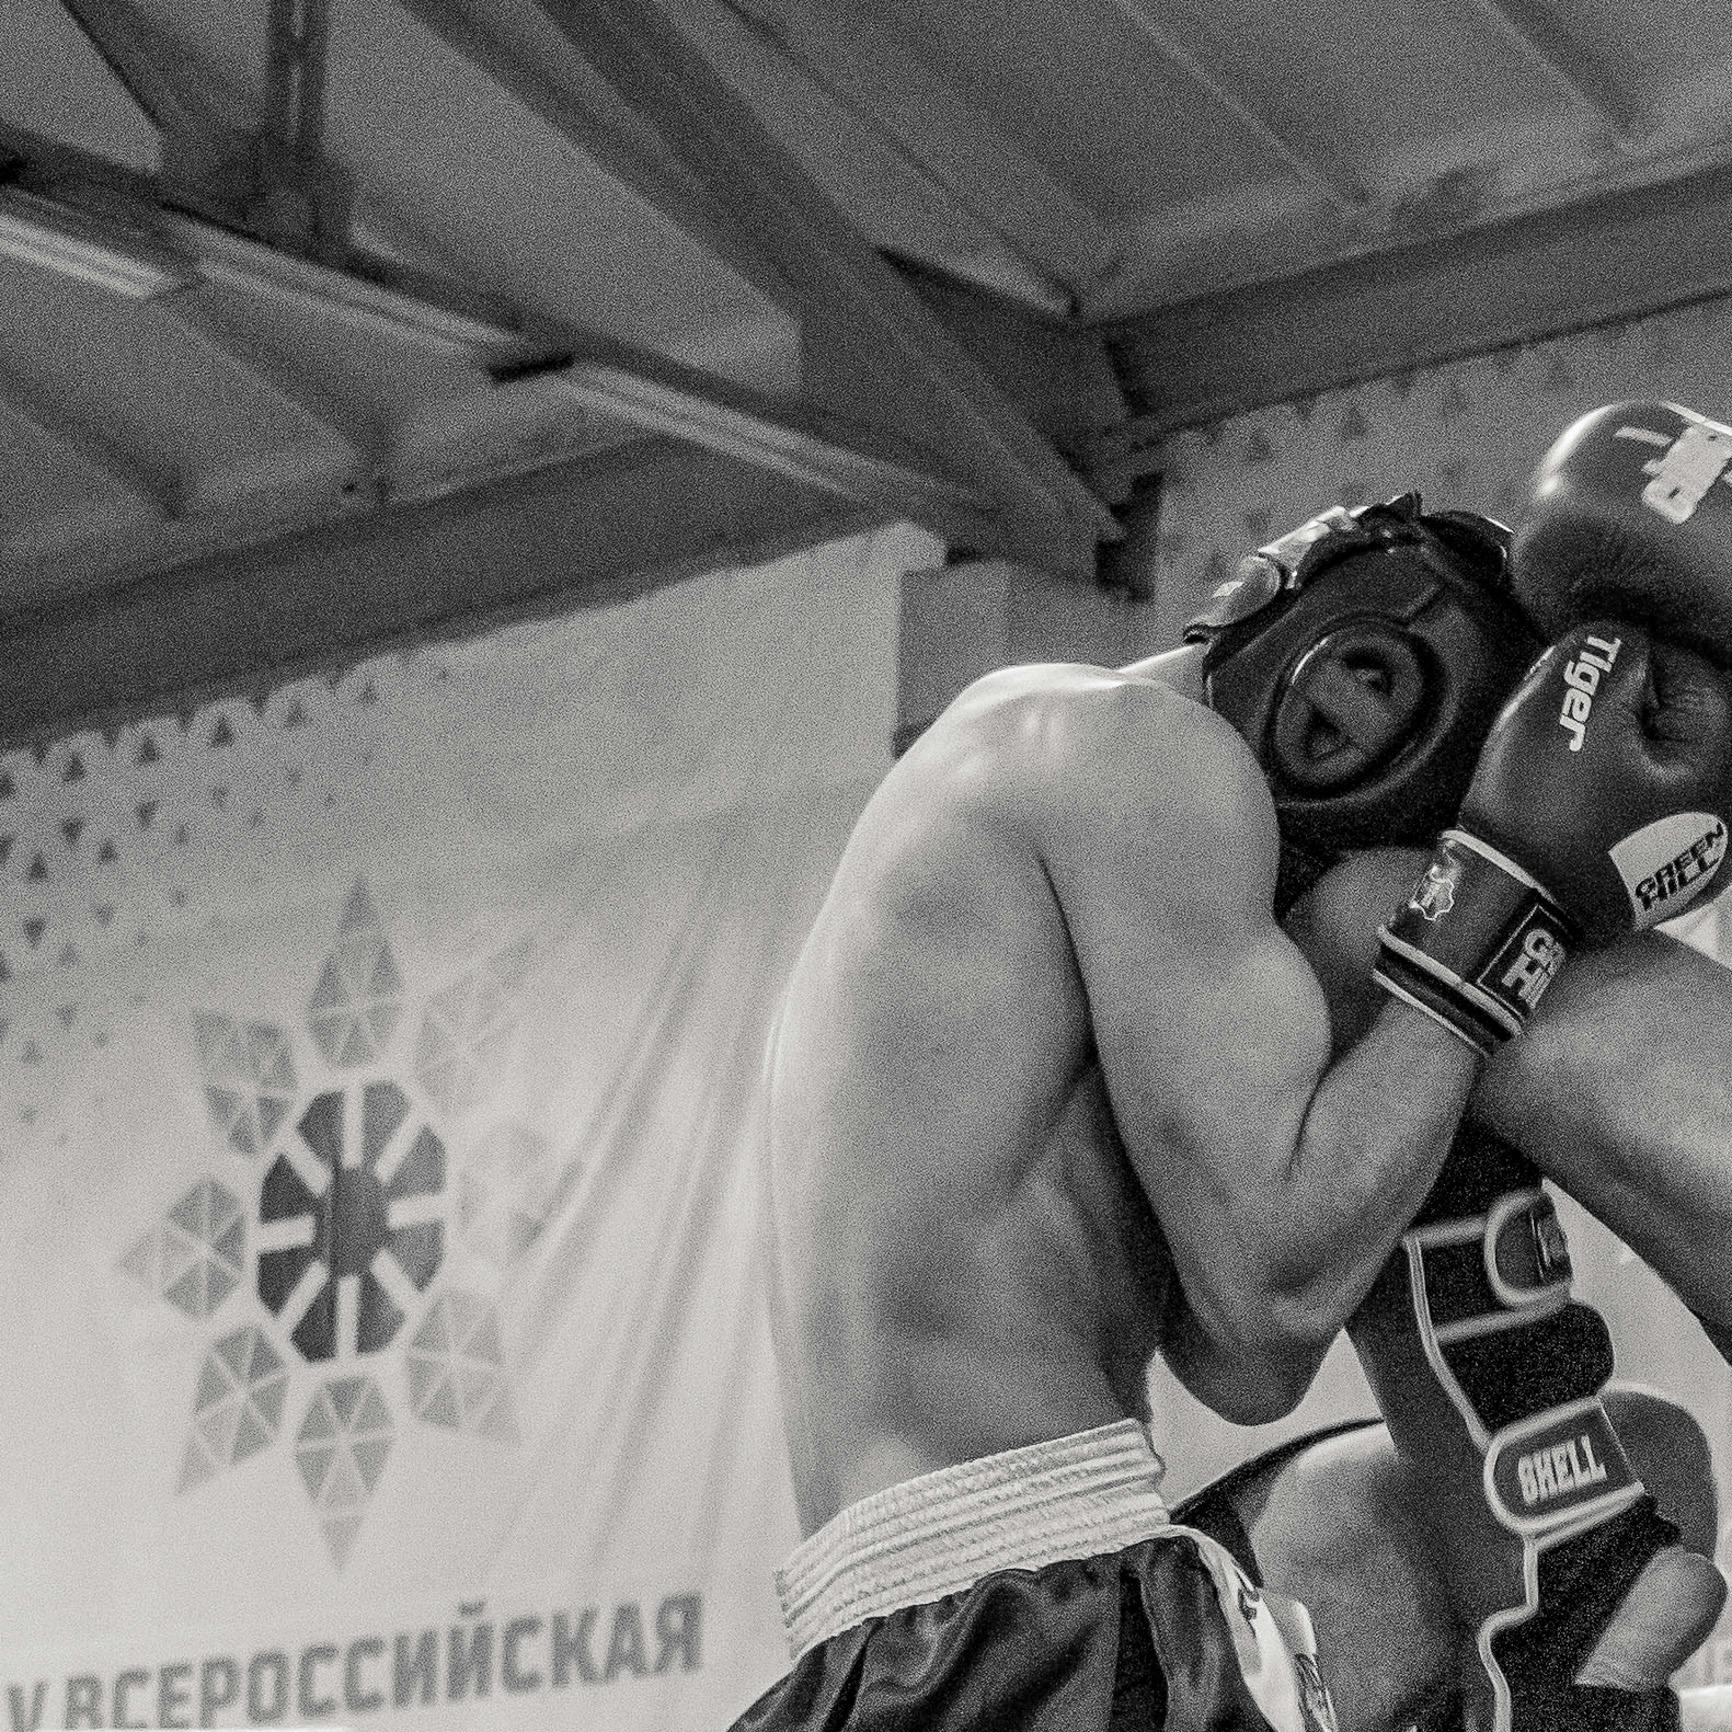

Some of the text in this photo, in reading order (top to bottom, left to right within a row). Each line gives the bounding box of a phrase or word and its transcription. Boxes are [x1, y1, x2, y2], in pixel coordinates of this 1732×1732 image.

[1559, 635, 1621, 752] Tiger
[1635, 821, 1724, 898] GREEN
[1641, 856, 1721, 911] HILL
[64, 1590, 704, 1730] ВСЕРОССИЙСКАЯ
